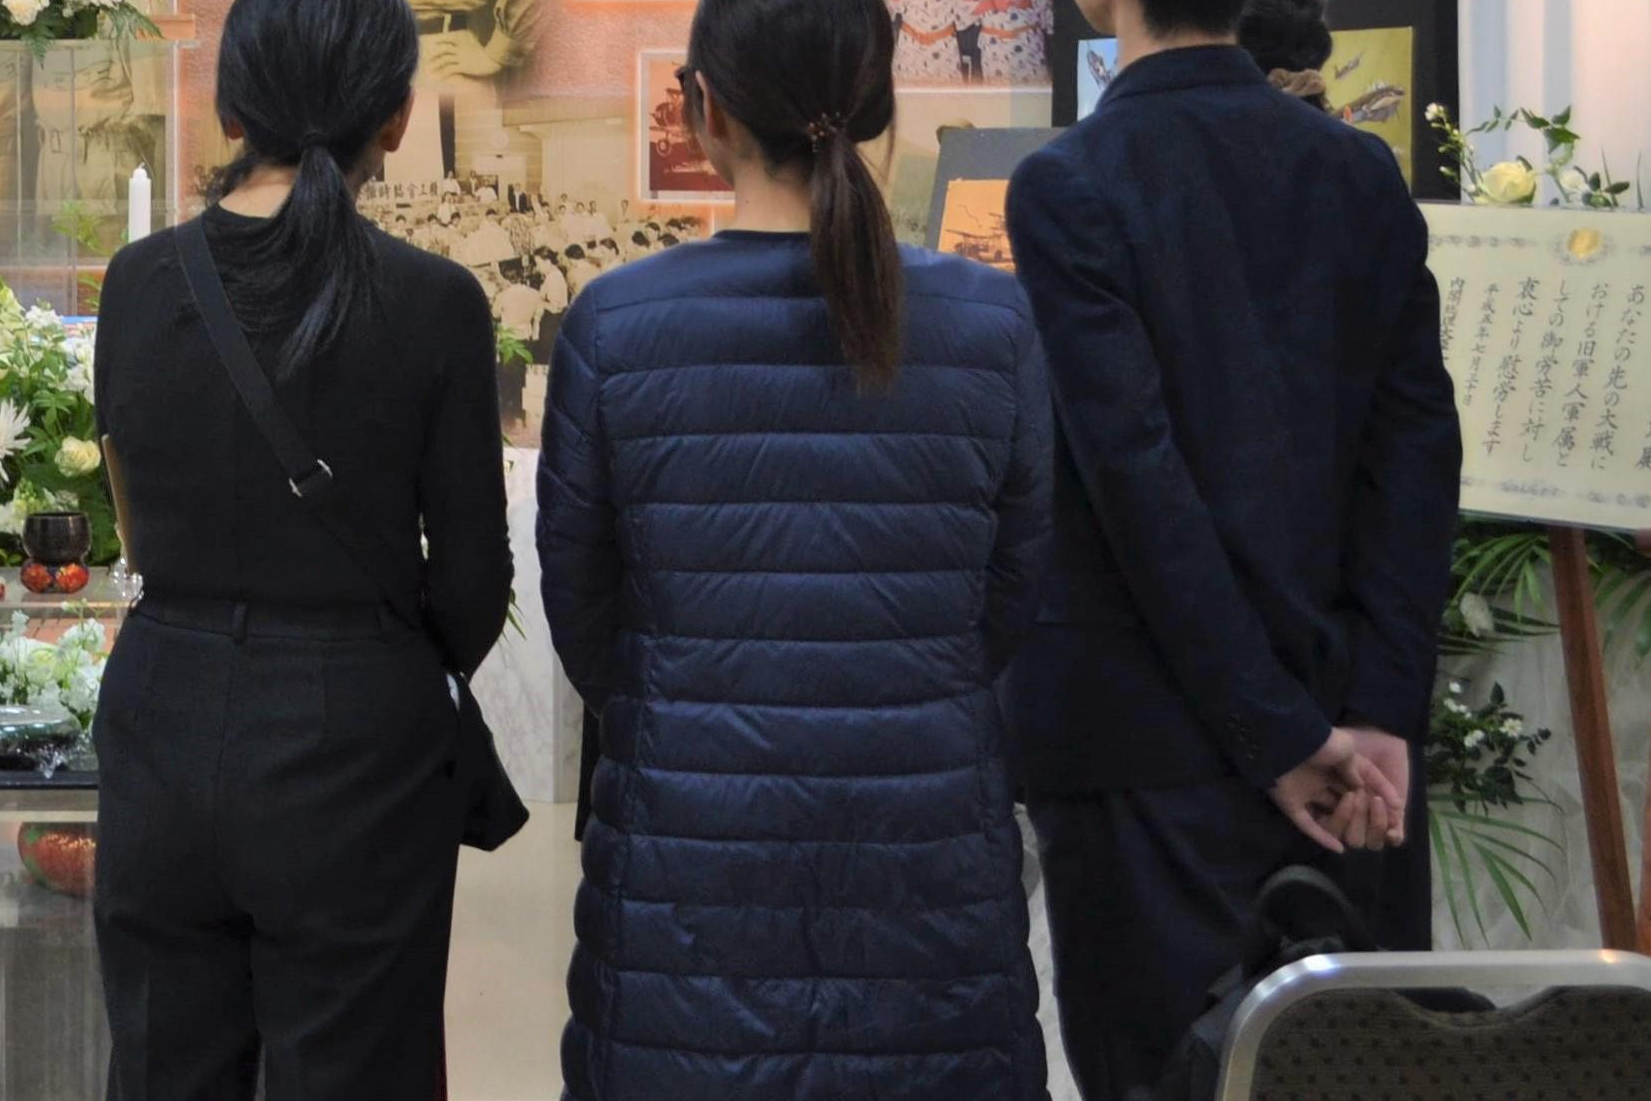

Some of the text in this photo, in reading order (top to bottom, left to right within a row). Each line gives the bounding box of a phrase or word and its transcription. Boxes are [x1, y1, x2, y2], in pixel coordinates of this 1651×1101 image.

[1520, 279, 1569, 462] しての御労苦に対し
[1552, 283, 1608, 467] おける旧軍人軍属と
[1591, 284, 1645, 470] あなたの先の大戦に
